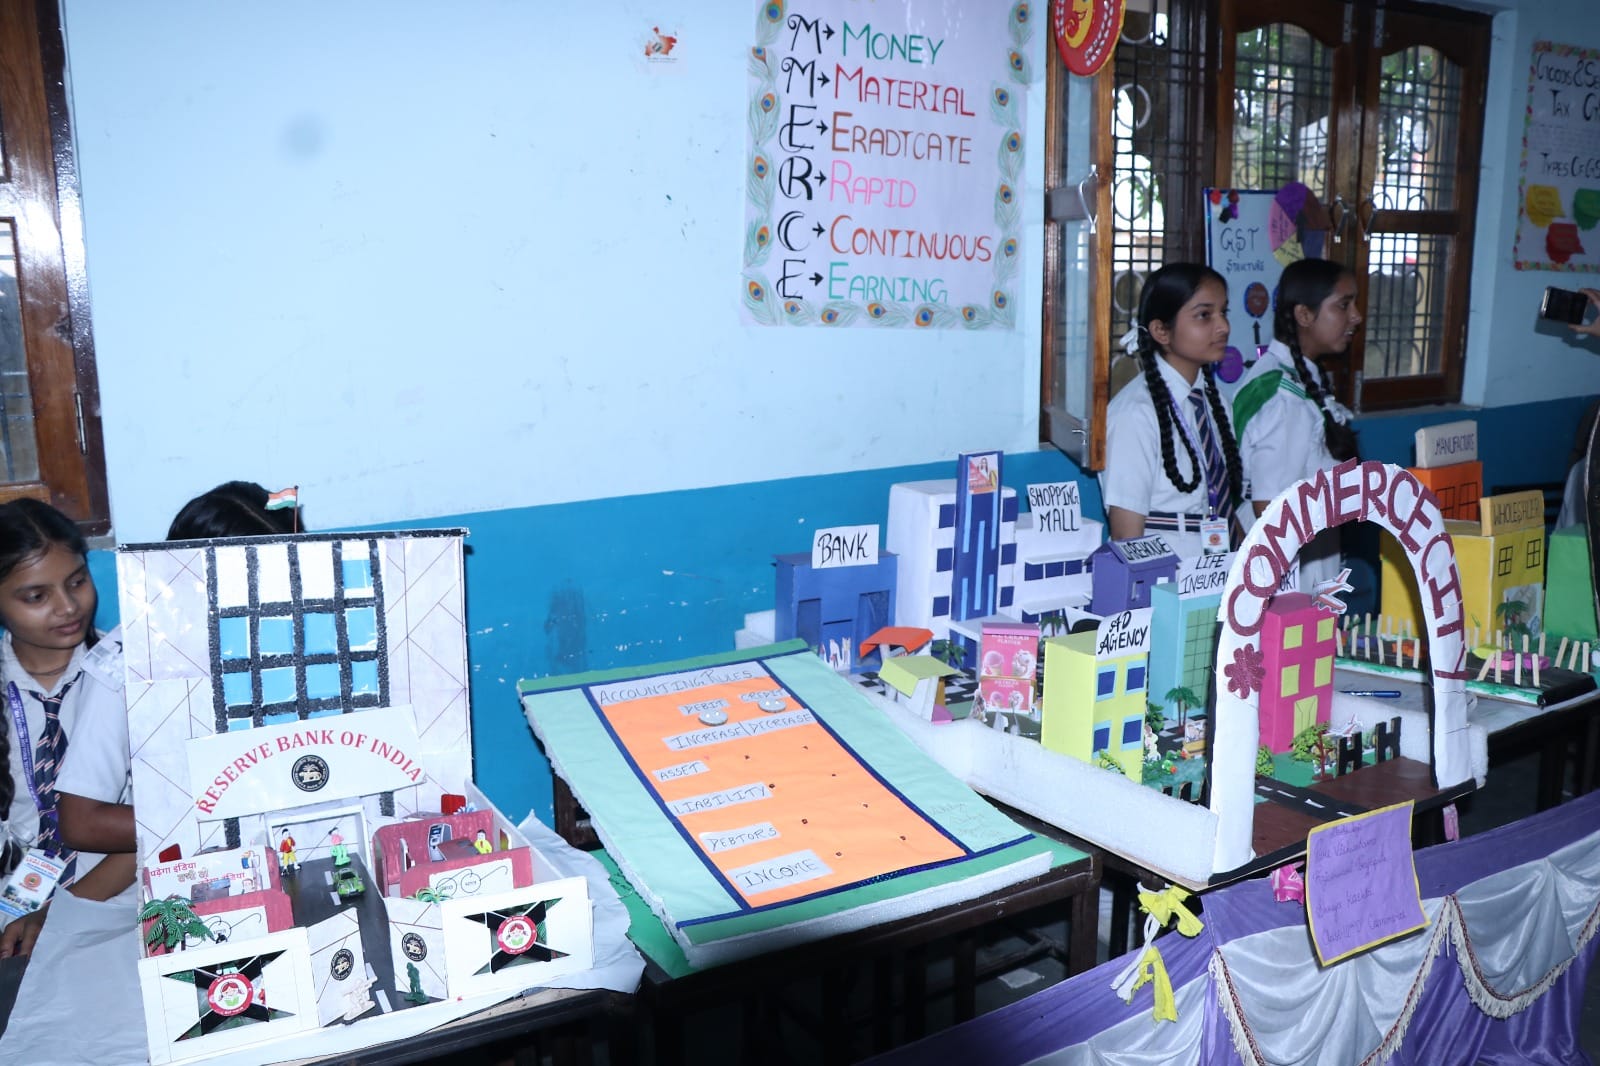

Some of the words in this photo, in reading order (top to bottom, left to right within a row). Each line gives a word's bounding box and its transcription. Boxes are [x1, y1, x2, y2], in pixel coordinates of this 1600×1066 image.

[787, 14, 822, 54] M
[842, 21, 944, 65] MONEY
[781, 57, 815, 98] M
[834, 63, 975, 117] MATERIAL
[778, 104, 817, 153] E
[831, 111, 972, 164] ERADICATE
[778, 156, 813, 200] R
[829, 159, 917, 208] RAPID
[777, 210, 812, 252] C
[830, 214, 992, 262] CONTINUOUS
[1220, 227, 1259, 258] GST
[776, 259, 806, 300] E
[828, 261, 948, 304] EARNING
[1029, 483, 1080, 507] SHOPPING
[1040, 509, 1079, 532] MALL
[818, 531, 870, 565] BANK
[1195, 554, 1226, 570] LIFE
[1227, 457, 1440, 637] COMMERCE
[1177, 570, 1230, 595] INSURA
[1109, 611, 1132, 633] AD
[1098, 625, 1148, 655] AGENCY
[599, 676, 706, 705] ACCOUNTING
[701, 669, 752, 688] RULES
[685, 700, 724, 714] DEBIT
[196, 742, 274, 815] RESERVE
[275, 729, 335, 753] BANK
[340, 731, 368, 748] OF
[370, 738, 423, 783] INDIA
[660, 762, 701, 781] ASSET
[674, 785, 767, 815] LIABILITY
[707, 827, 777, 851] DEBTORS
[735, 858, 818, 888] INCOME
